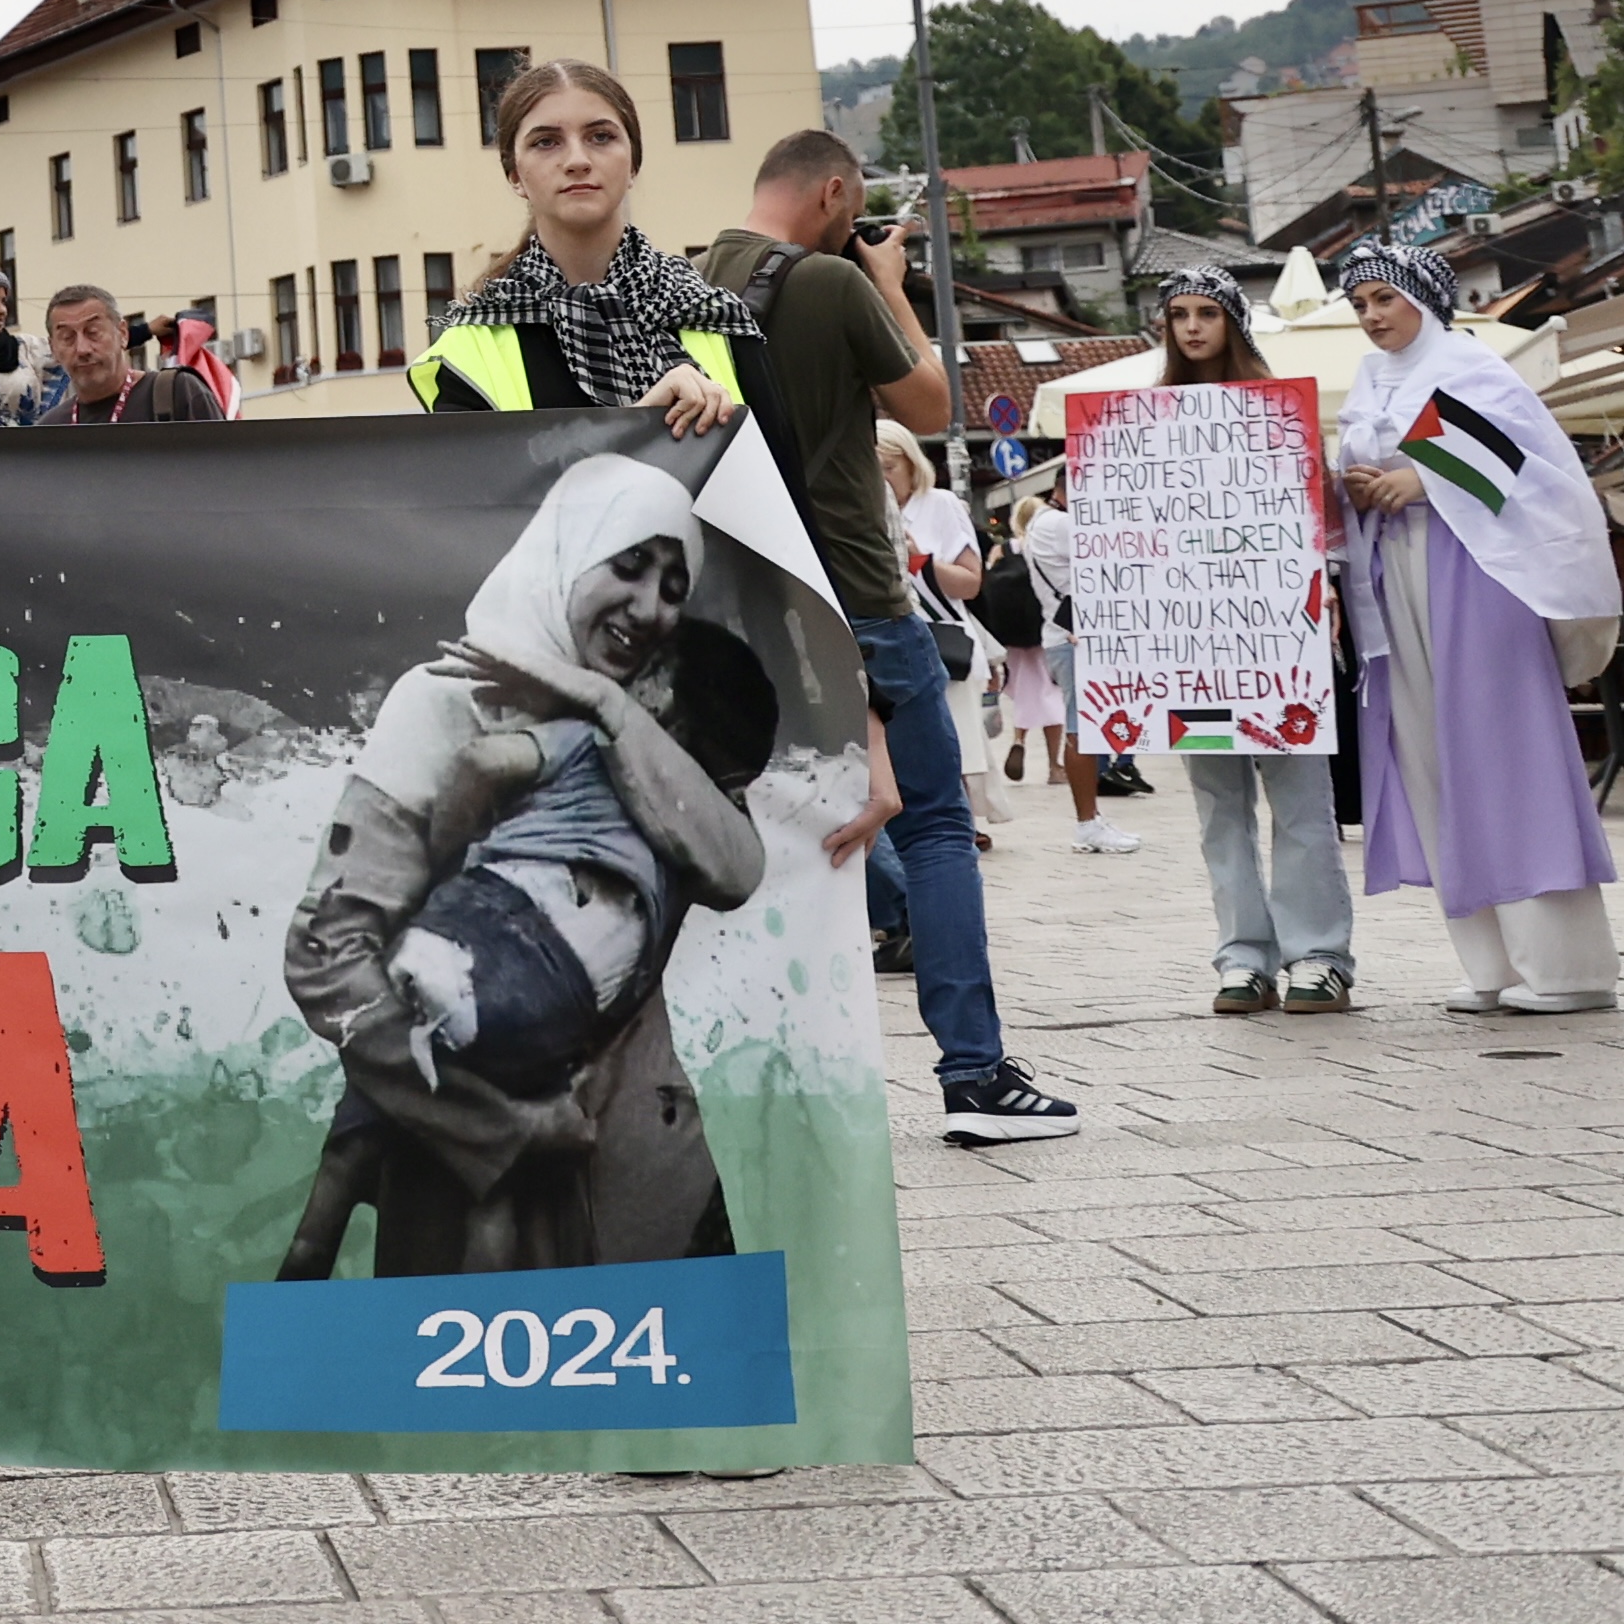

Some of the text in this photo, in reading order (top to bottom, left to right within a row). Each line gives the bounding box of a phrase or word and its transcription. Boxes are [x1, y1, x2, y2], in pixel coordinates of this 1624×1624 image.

[1080, 384, 1303, 426] WHEN YOU NEED
[1069, 432, 1096, 460] TO
[1102, 426, 1156, 460] HAVE
[1168, 418, 1308, 457] HUNDREDS
[1071, 452, 1317, 493] OF PROTEST JUST TO
[1105, 496, 1143, 523] THE
[1147, 490, 1241, 524] WORLD
[1245, 487, 1309, 518] THAT
[1177, 522, 1303, 555] CHILDREN
[1074, 566, 1096, 594] IS
[1101, 563, 1154, 595] NOT
[1198, 557, 1268, 591] THAT
[1277, 559, 1303, 590] IS
[1073, 595, 1300, 631] WHEN YOU KNOW
[1079, 631, 1307, 665] THAT HUMANITY
[1109, 670, 1169, 704] HAS
[416, 1307, 691, 1388] 2024.
